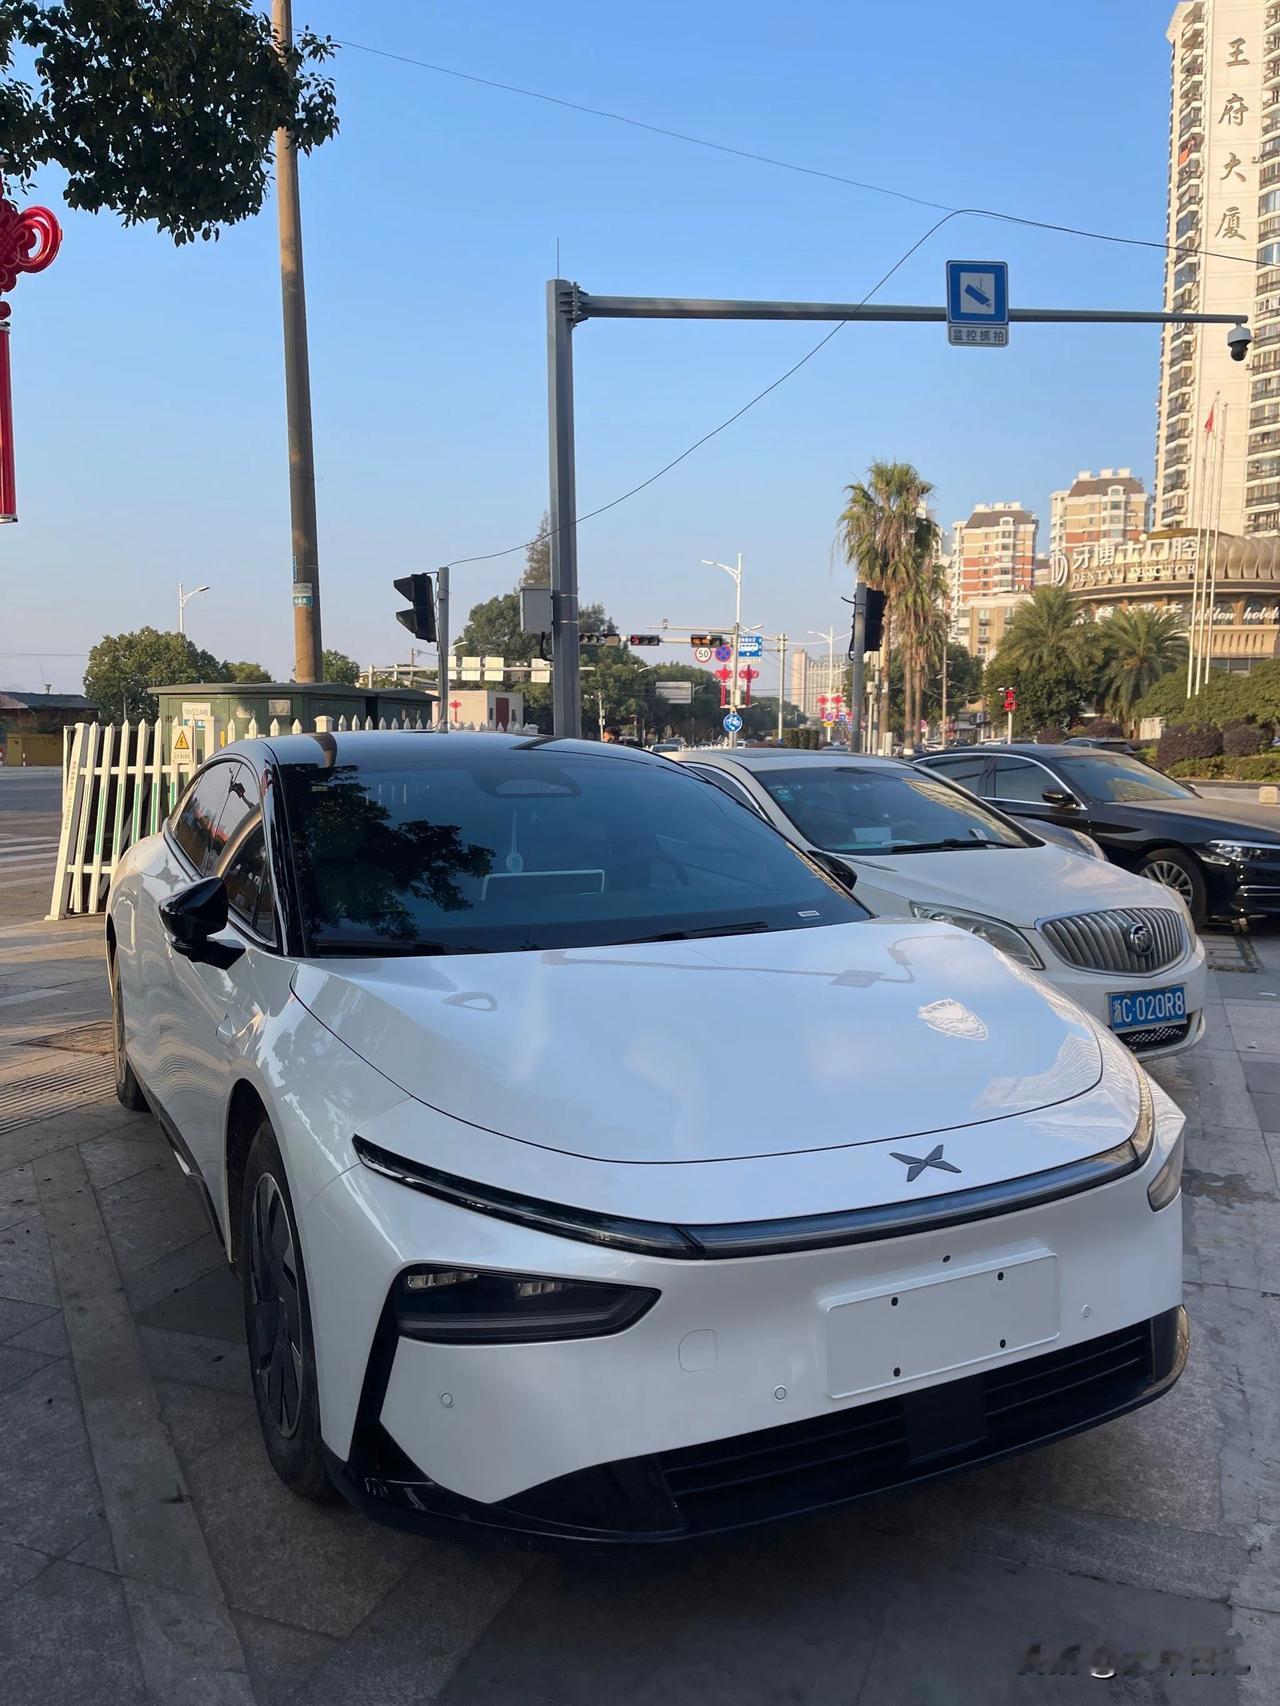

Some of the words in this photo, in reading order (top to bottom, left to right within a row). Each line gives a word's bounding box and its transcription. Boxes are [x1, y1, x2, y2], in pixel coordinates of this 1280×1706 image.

[1215, 37, 1250, 240] 王府大厦
[953, 329, 1004, 342] 监控抓拍
[1072, 536, 1197, 570] 牙博士口腔
[1072, 568, 1120, 584] DENTAL
[1130, 564, 1196, 578] DOCTOR
